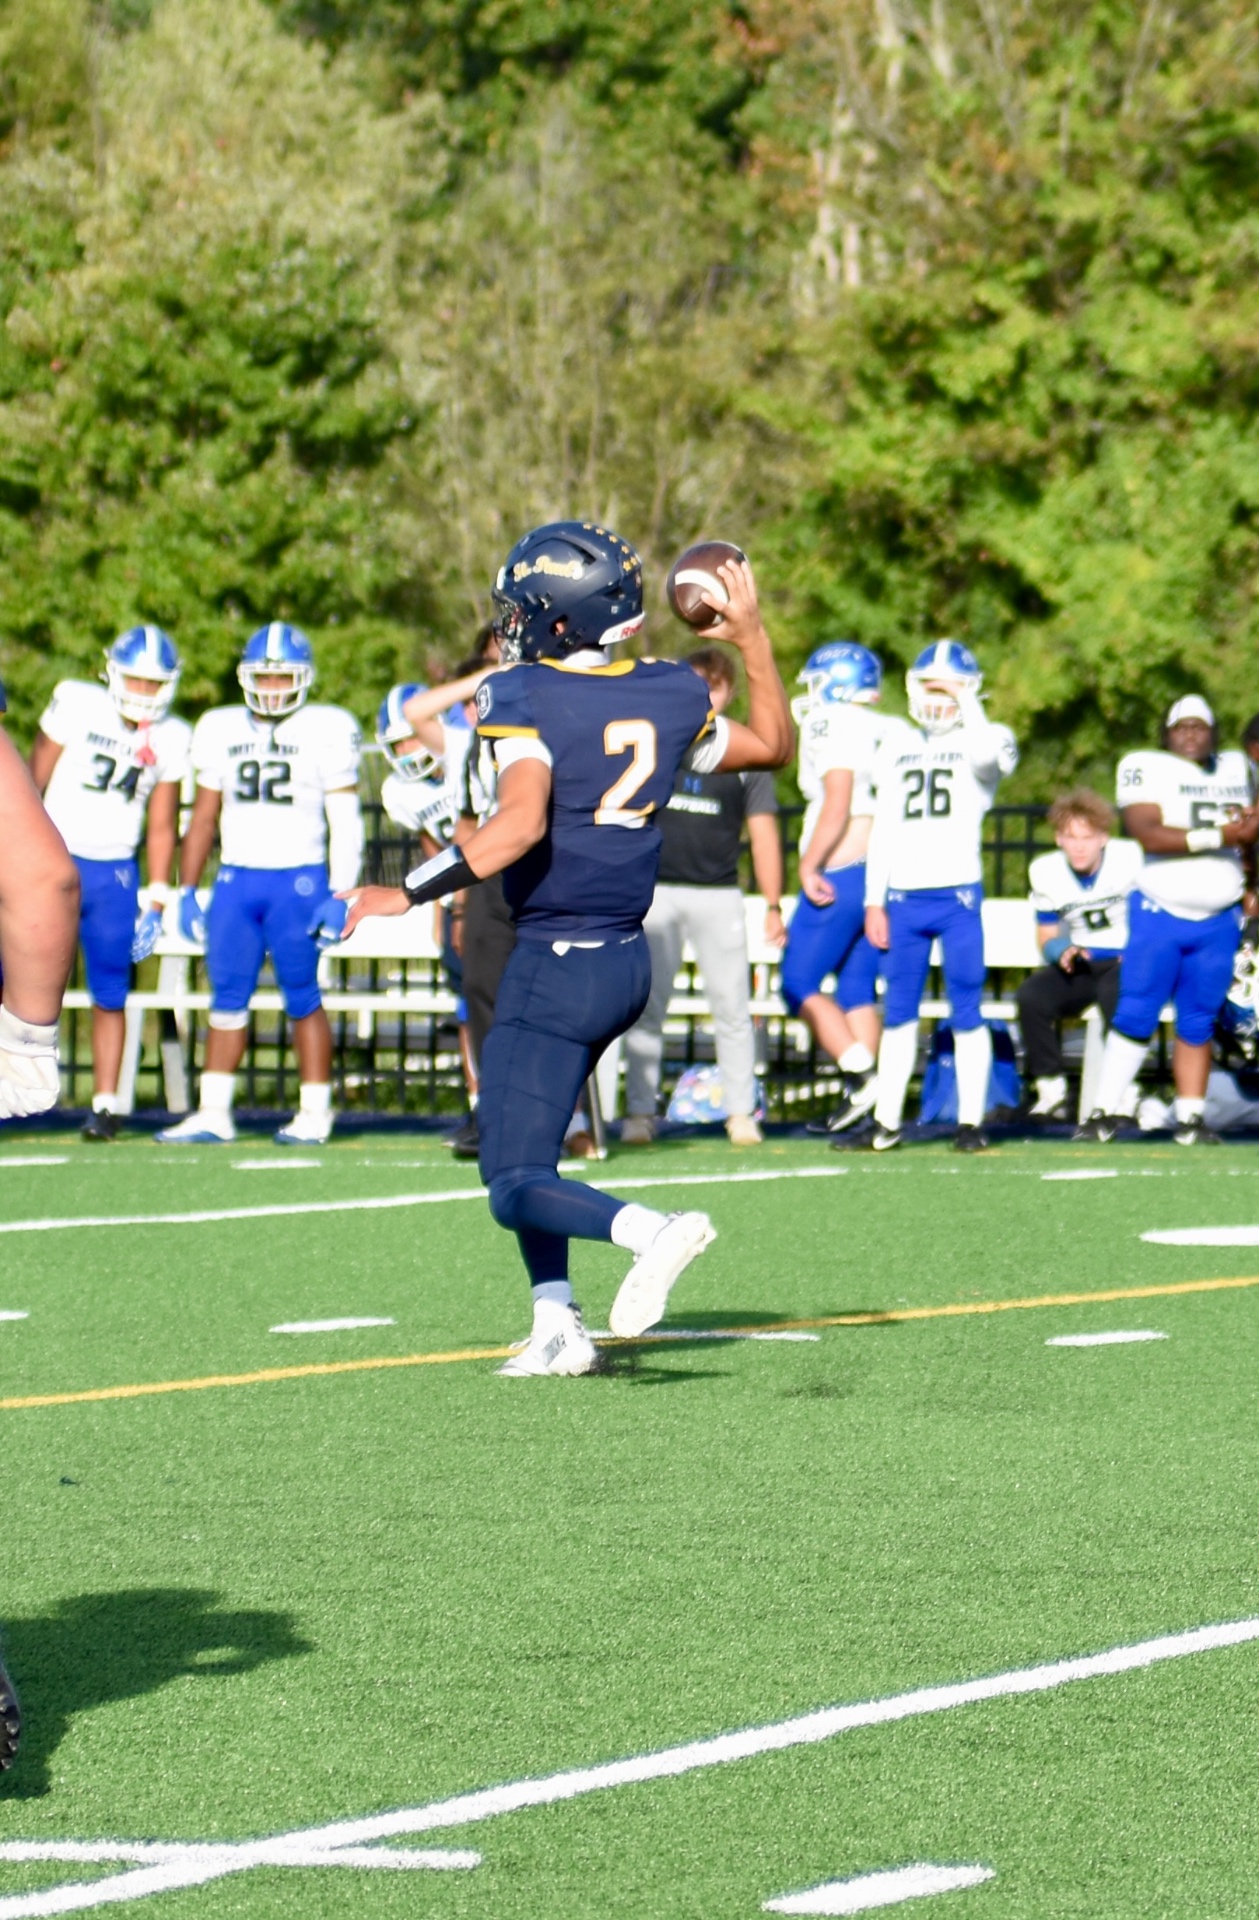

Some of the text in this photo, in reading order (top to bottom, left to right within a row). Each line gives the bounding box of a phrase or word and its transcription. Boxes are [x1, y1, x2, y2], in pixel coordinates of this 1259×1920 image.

[82, 752, 145, 803] 34
[234, 759, 293, 805] 92
[594, 719, 657, 829] 2
[903, 767, 953, 820] 26
[1122, 767, 1144, 787] 56
